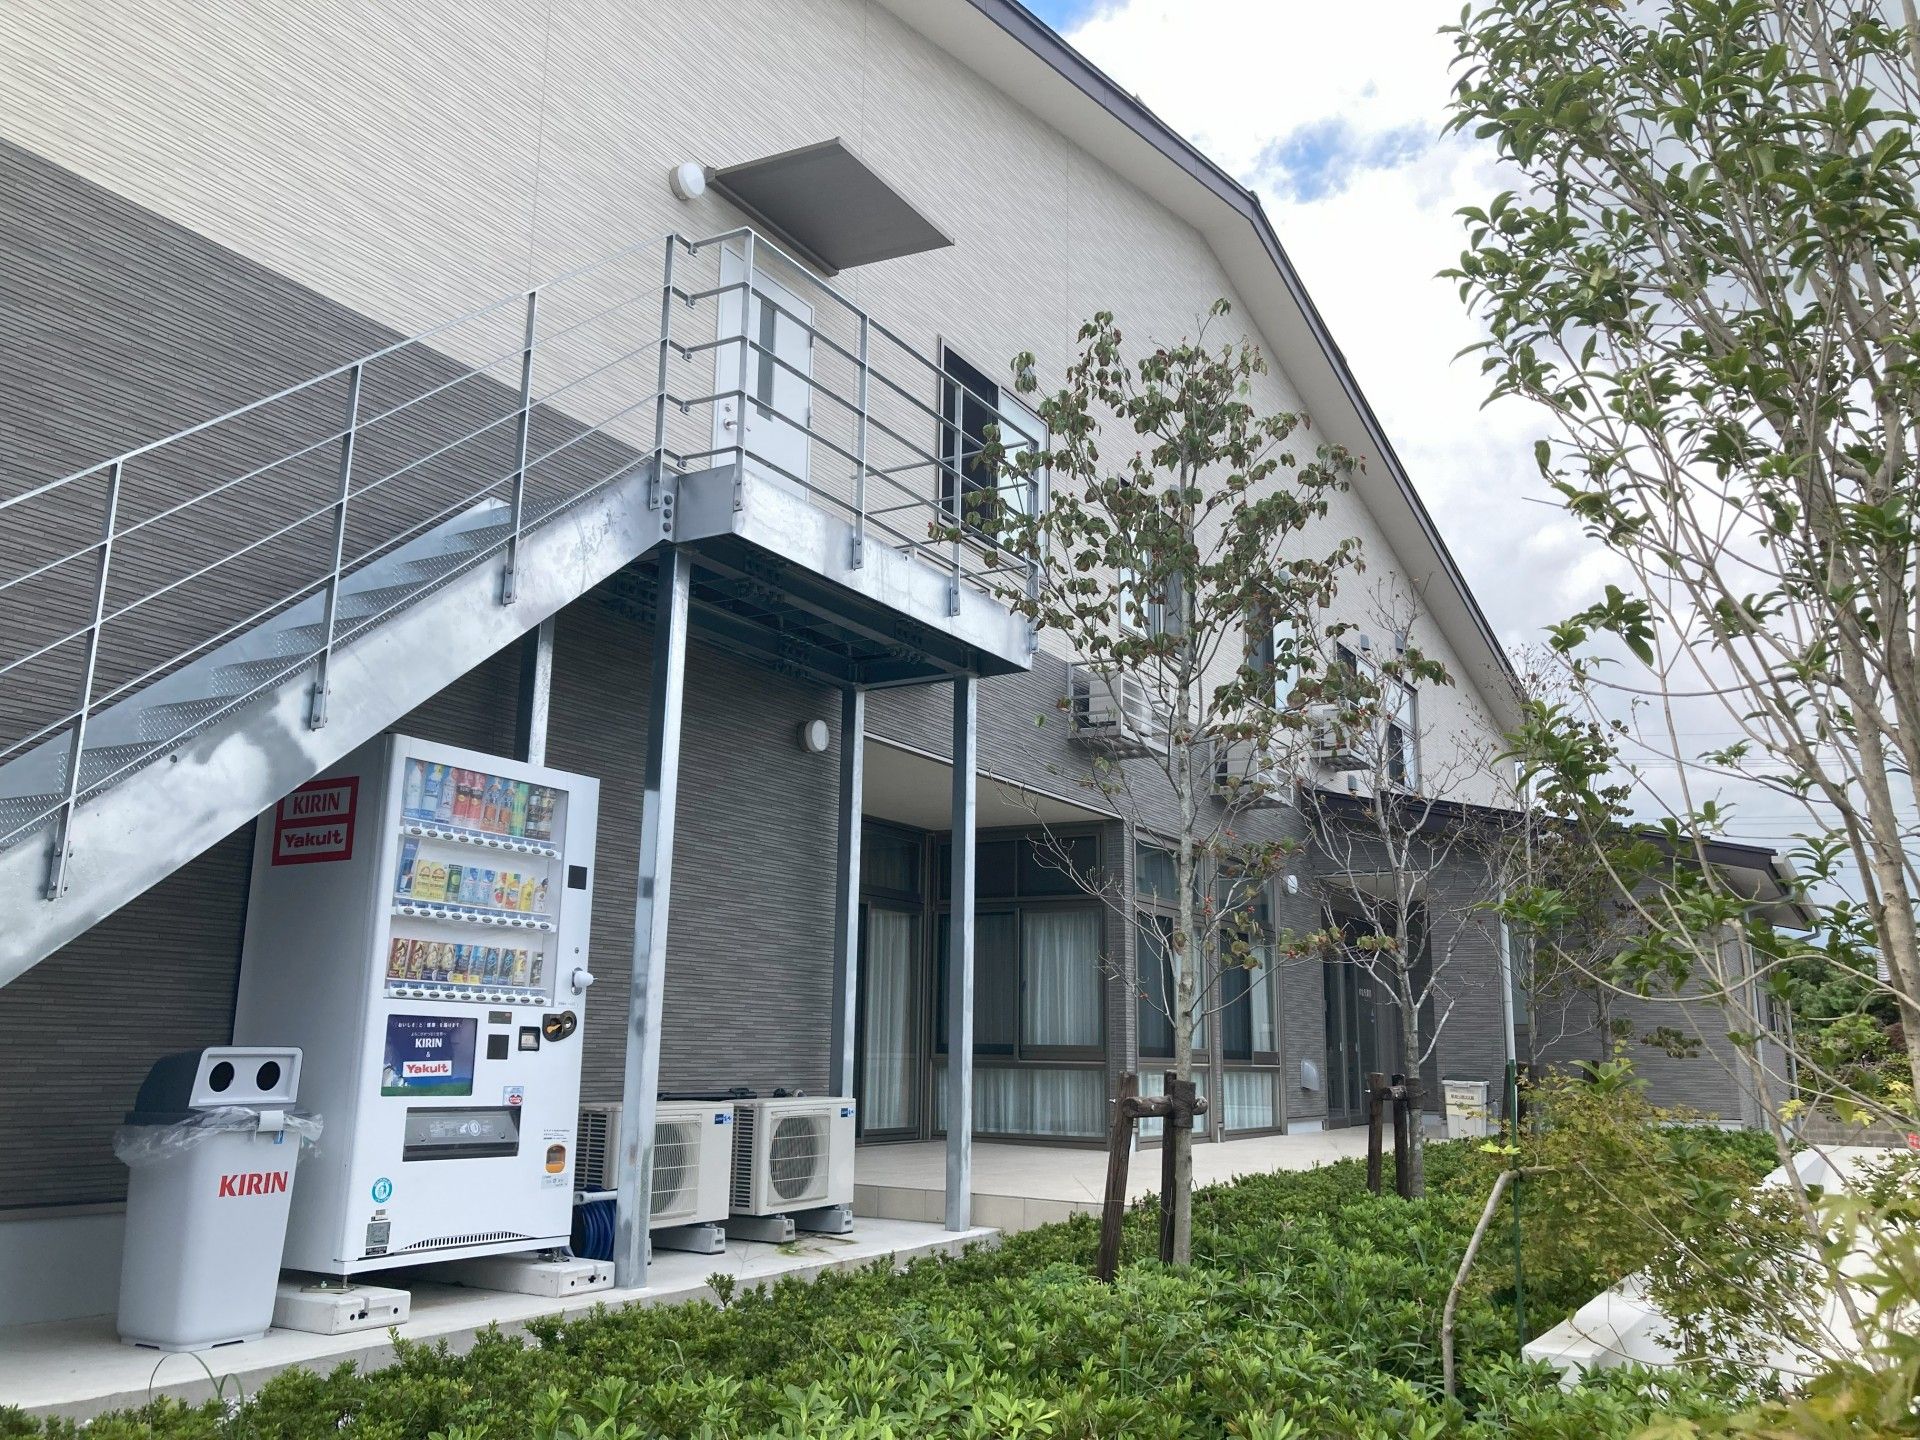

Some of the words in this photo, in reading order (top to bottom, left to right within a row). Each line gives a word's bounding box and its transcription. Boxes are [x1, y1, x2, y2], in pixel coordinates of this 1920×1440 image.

[292, 791, 341, 815] KIRIN
[284, 829, 344, 848] Yakult
[415, 1038, 443, 1048] KIRIN
[406, 1063, 449, 1074] Yakult
[218, 1171, 288, 1198] KIRIN
